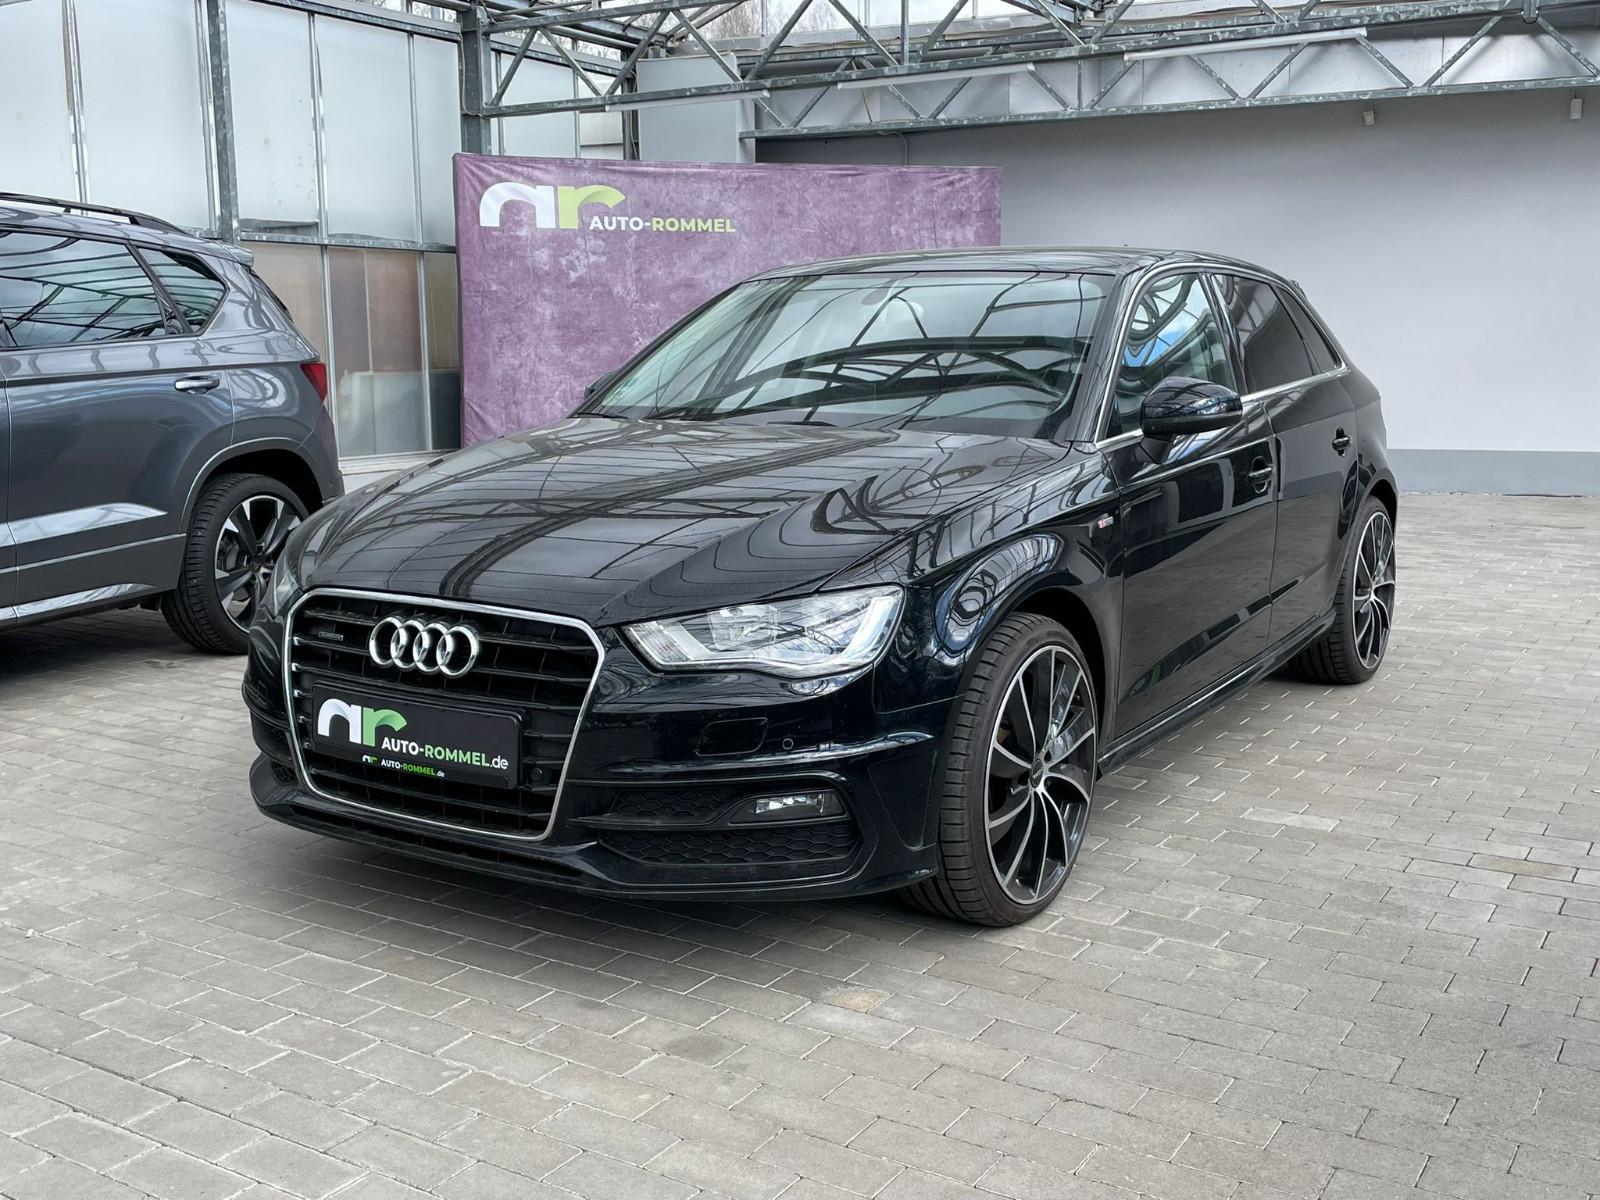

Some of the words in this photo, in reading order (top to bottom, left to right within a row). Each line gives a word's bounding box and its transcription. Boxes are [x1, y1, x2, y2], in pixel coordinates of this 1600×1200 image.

[589, 216, 736, 233] AUTO-ROMMEL
[381, 736, 509, 770] AUTO-ROMMEL.de
[381, 759, 445, 778] AUTO-ROMMEL.de
